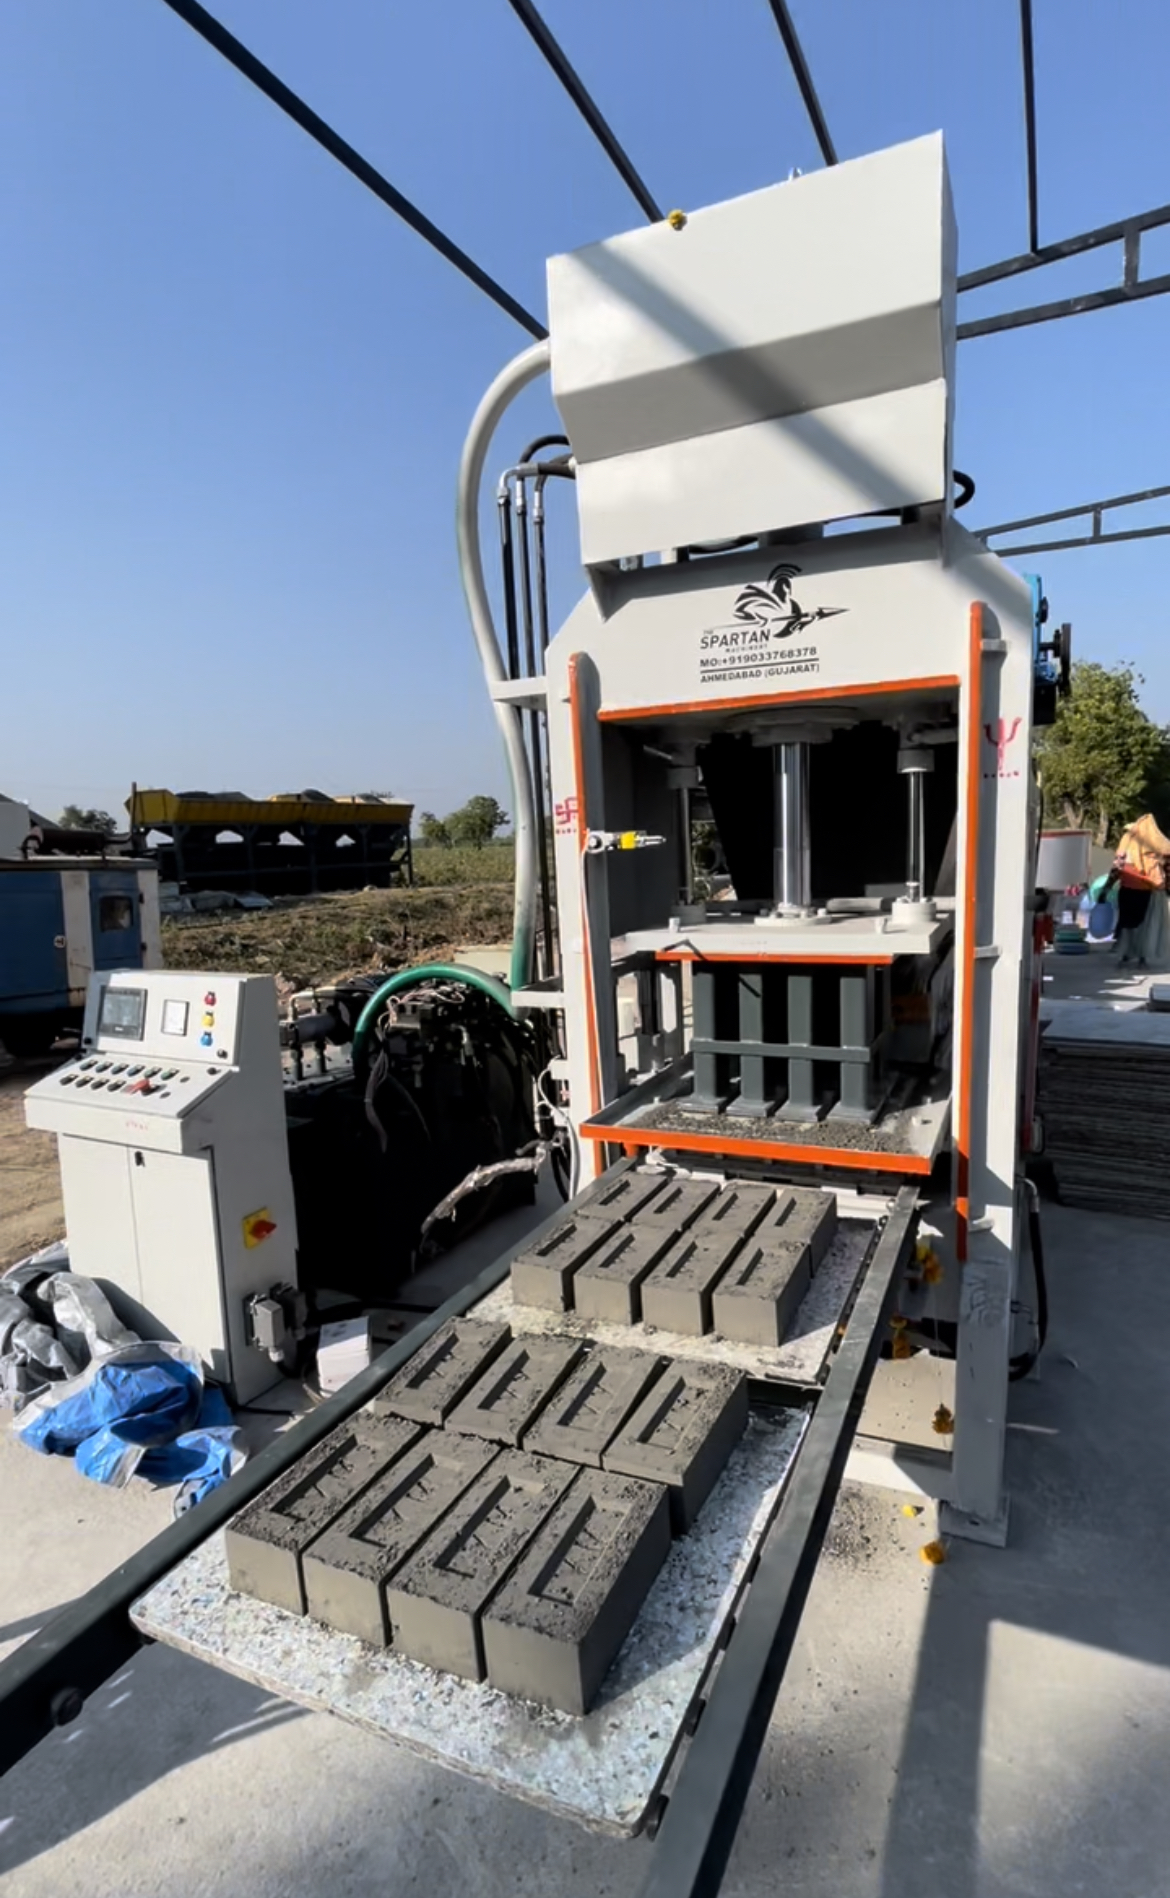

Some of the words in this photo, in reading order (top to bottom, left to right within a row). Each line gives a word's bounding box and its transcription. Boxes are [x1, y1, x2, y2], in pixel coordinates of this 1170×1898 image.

[700, 629, 770, 649] SPARTAN
[700, 669, 762, 683] AHMEDABAD
[764, 663, 819, 678] (GUJARAT)
